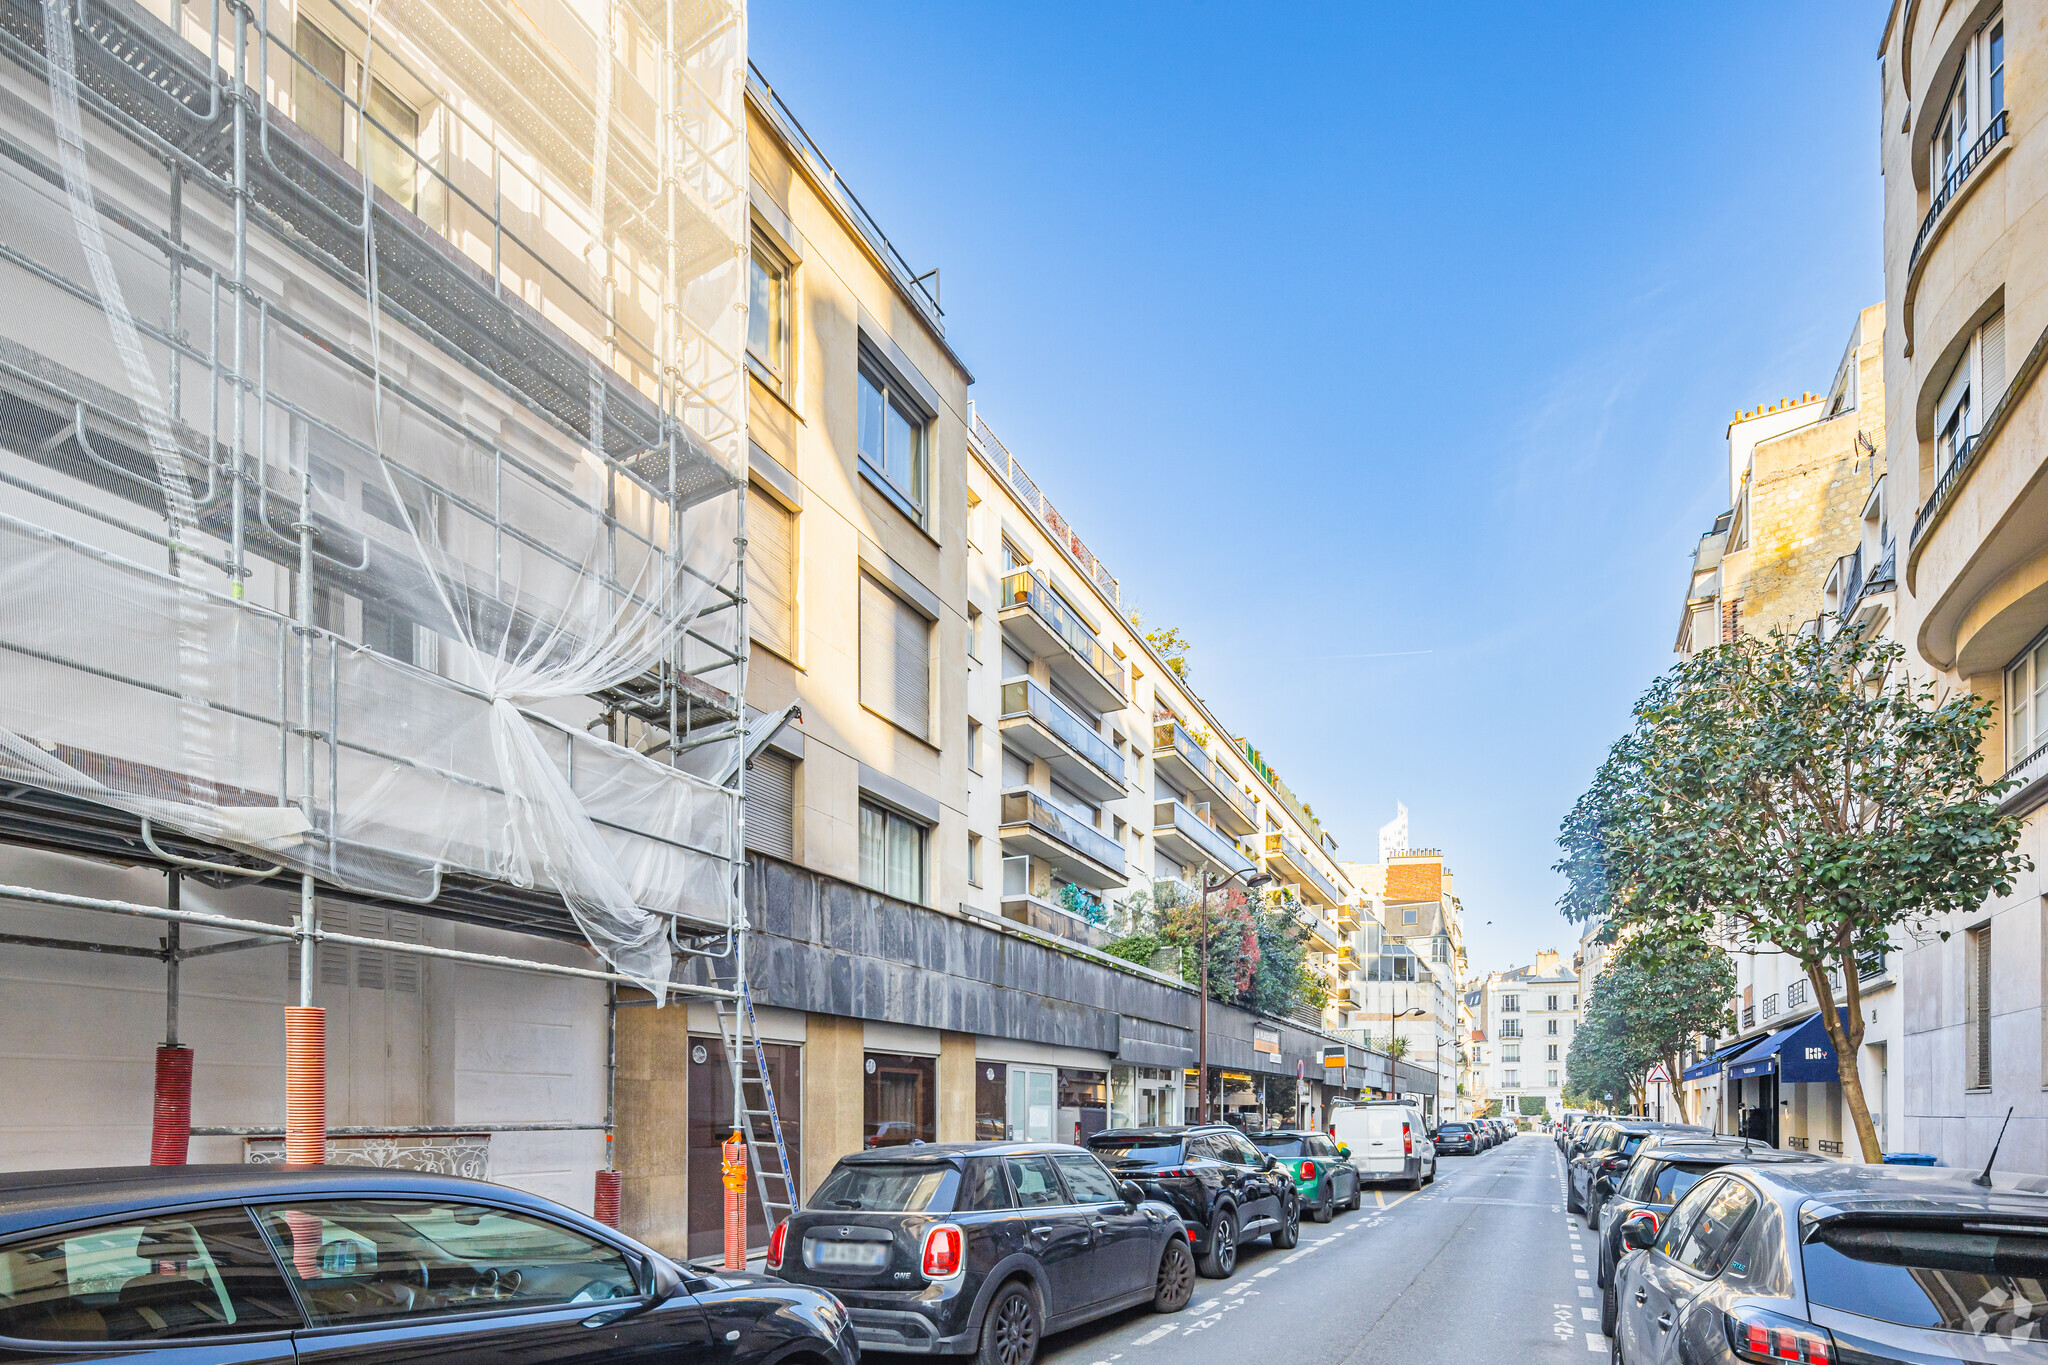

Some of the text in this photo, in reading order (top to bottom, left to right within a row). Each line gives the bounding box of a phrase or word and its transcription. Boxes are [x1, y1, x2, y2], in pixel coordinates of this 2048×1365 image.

[1805, 1047, 1822, 1060] RS
[893, 1272, 911, 1280] ONE
[1182, 1290, 1261, 1336] PAYANT
